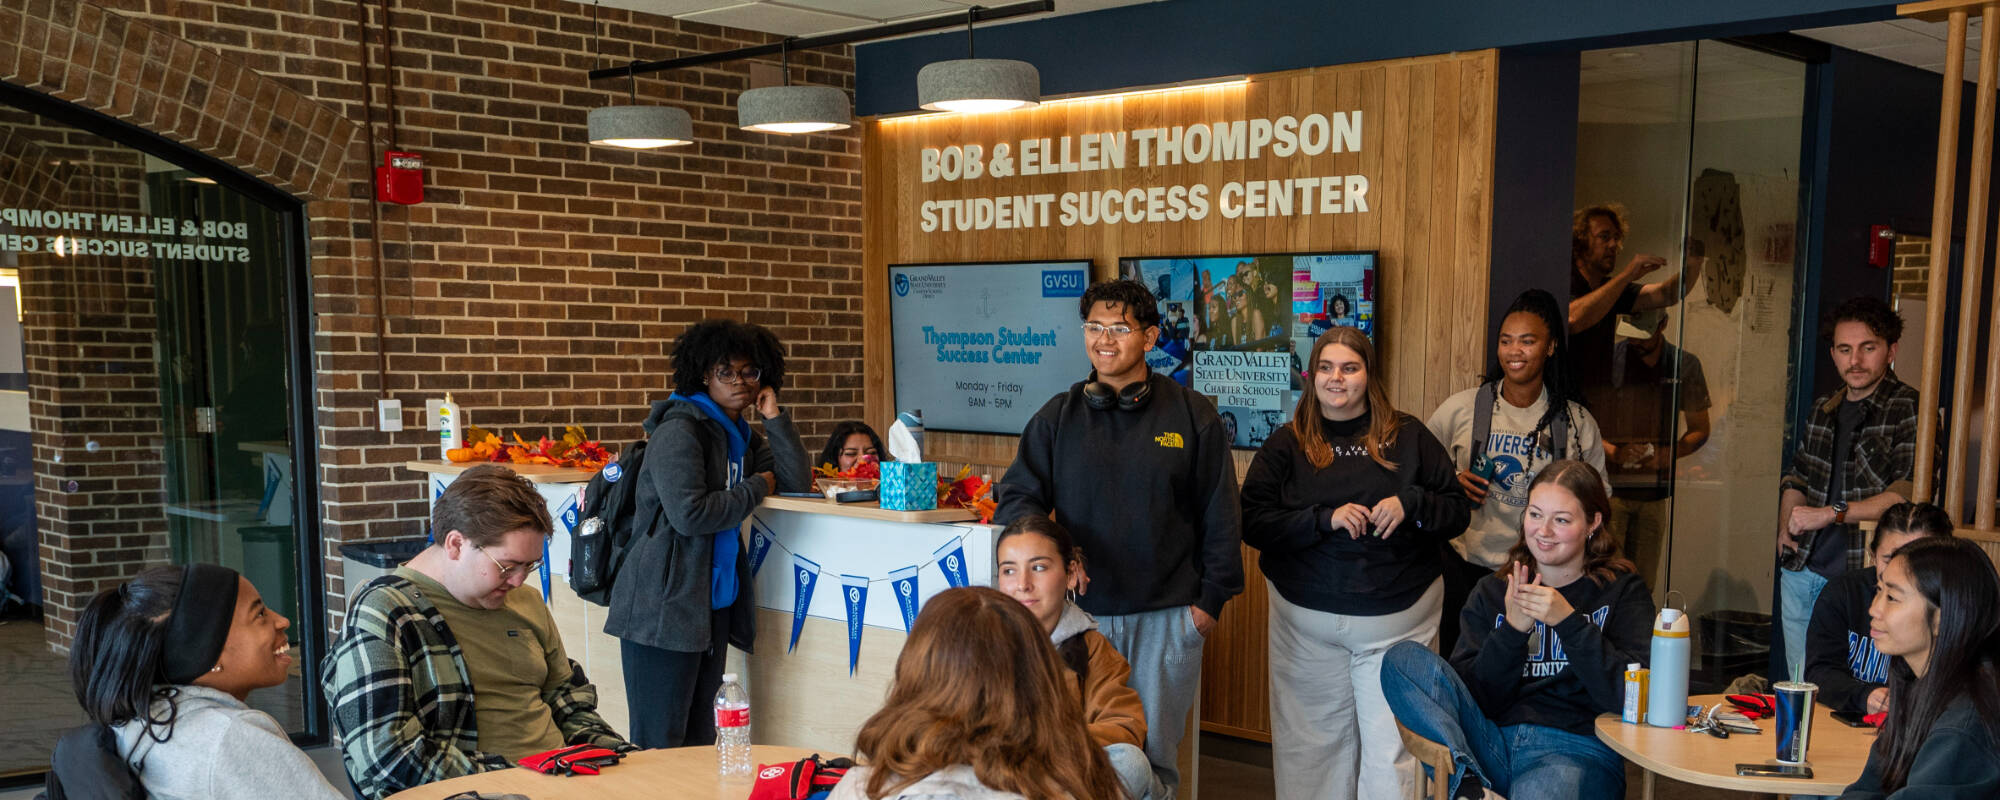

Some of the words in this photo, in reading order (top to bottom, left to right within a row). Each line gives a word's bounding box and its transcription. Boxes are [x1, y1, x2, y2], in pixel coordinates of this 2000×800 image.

[921, 145, 984, 183] BOB
[989, 143, 1015, 177] &
[1020, 132, 1127, 176] ELLEN
[1132, 111, 1364, 167] THOMPSON
[920, 193, 1056, 233] STUDENT
[1059, 184, 1210, 227] SUCCESS
[1219, 174, 1370, 219] CENTER
[1044, 274, 1078, 289] GVSU
[921, 325, 995, 349] Thompson
[999, 327, 1057, 347] Student
[936, 345, 989, 363] Success
[991, 345, 1043, 365] Center
[1195, 351, 1243, 367] GRAND
[1242, 351, 1289, 368] VALLEY
[1195, 366, 1224, 380] STATE
[1225, 368, 1289, 382] UNIVERSITY
[955, 381, 988, 394] Monday
[997, 381, 1023, 395] Friday
[1204, 383, 1241, 395] CHARTER
[1242, 384, 1280, 396] SCHOOLS
[968, 397, 986, 408] 9AM
[995, 398, 1013, 409] 5PM
[1228, 395, 1257, 407] OFFICE
[1848, 629, 1891, 685] RAND
[1532, 661, 1570, 677] UNIV
